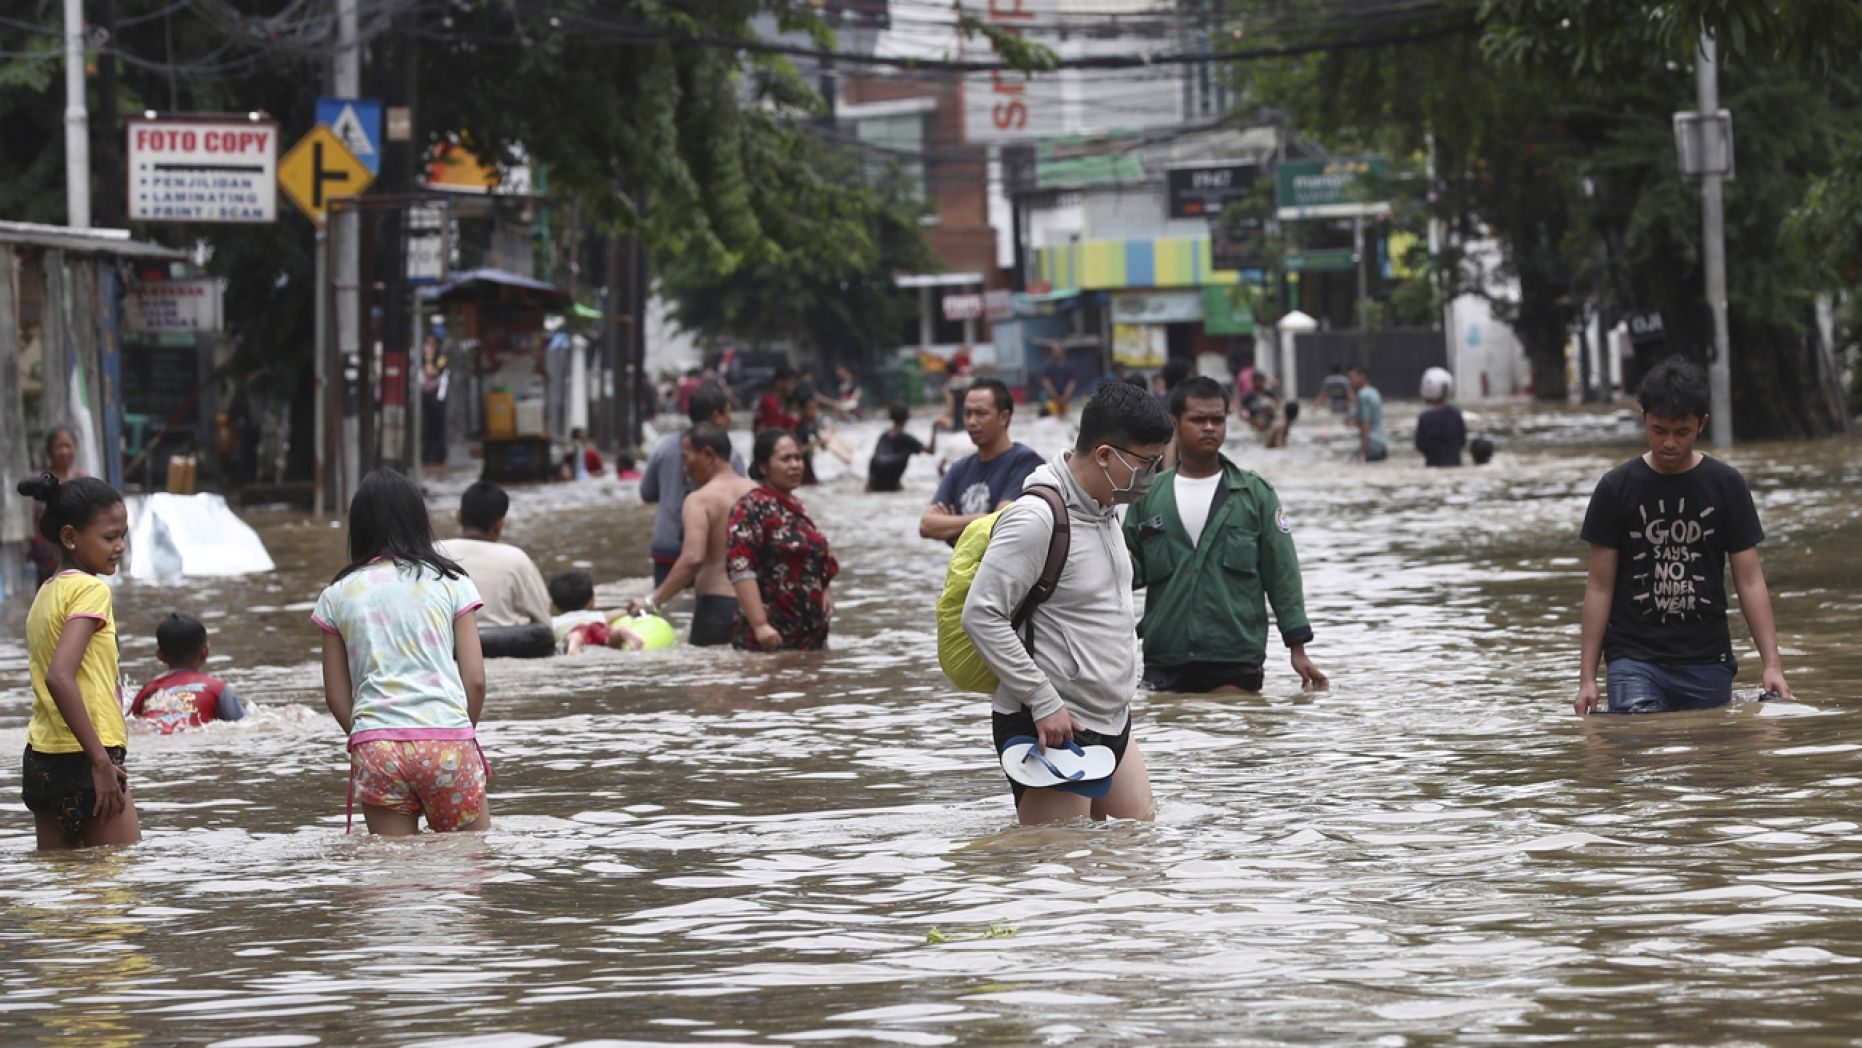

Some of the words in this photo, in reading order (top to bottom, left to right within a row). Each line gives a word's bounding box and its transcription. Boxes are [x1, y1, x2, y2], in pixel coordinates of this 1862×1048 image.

[136, 130, 197, 153] FOTO
[204, 131, 268, 153] COPY
[153, 177, 253, 189] PENJILIDAN
[153, 193, 258, 204] LAMINATING
[153, 207, 202, 216] PRINT
[218, 207, 264, 218] SCAN
[1645, 519, 1701, 544] GOD
[1653, 545, 1690, 561] SAYS
[1654, 562, 1685, 580] NO
[1653, 580, 1695, 595] UNDER
[1655, 596, 1696, 612] WEAR
